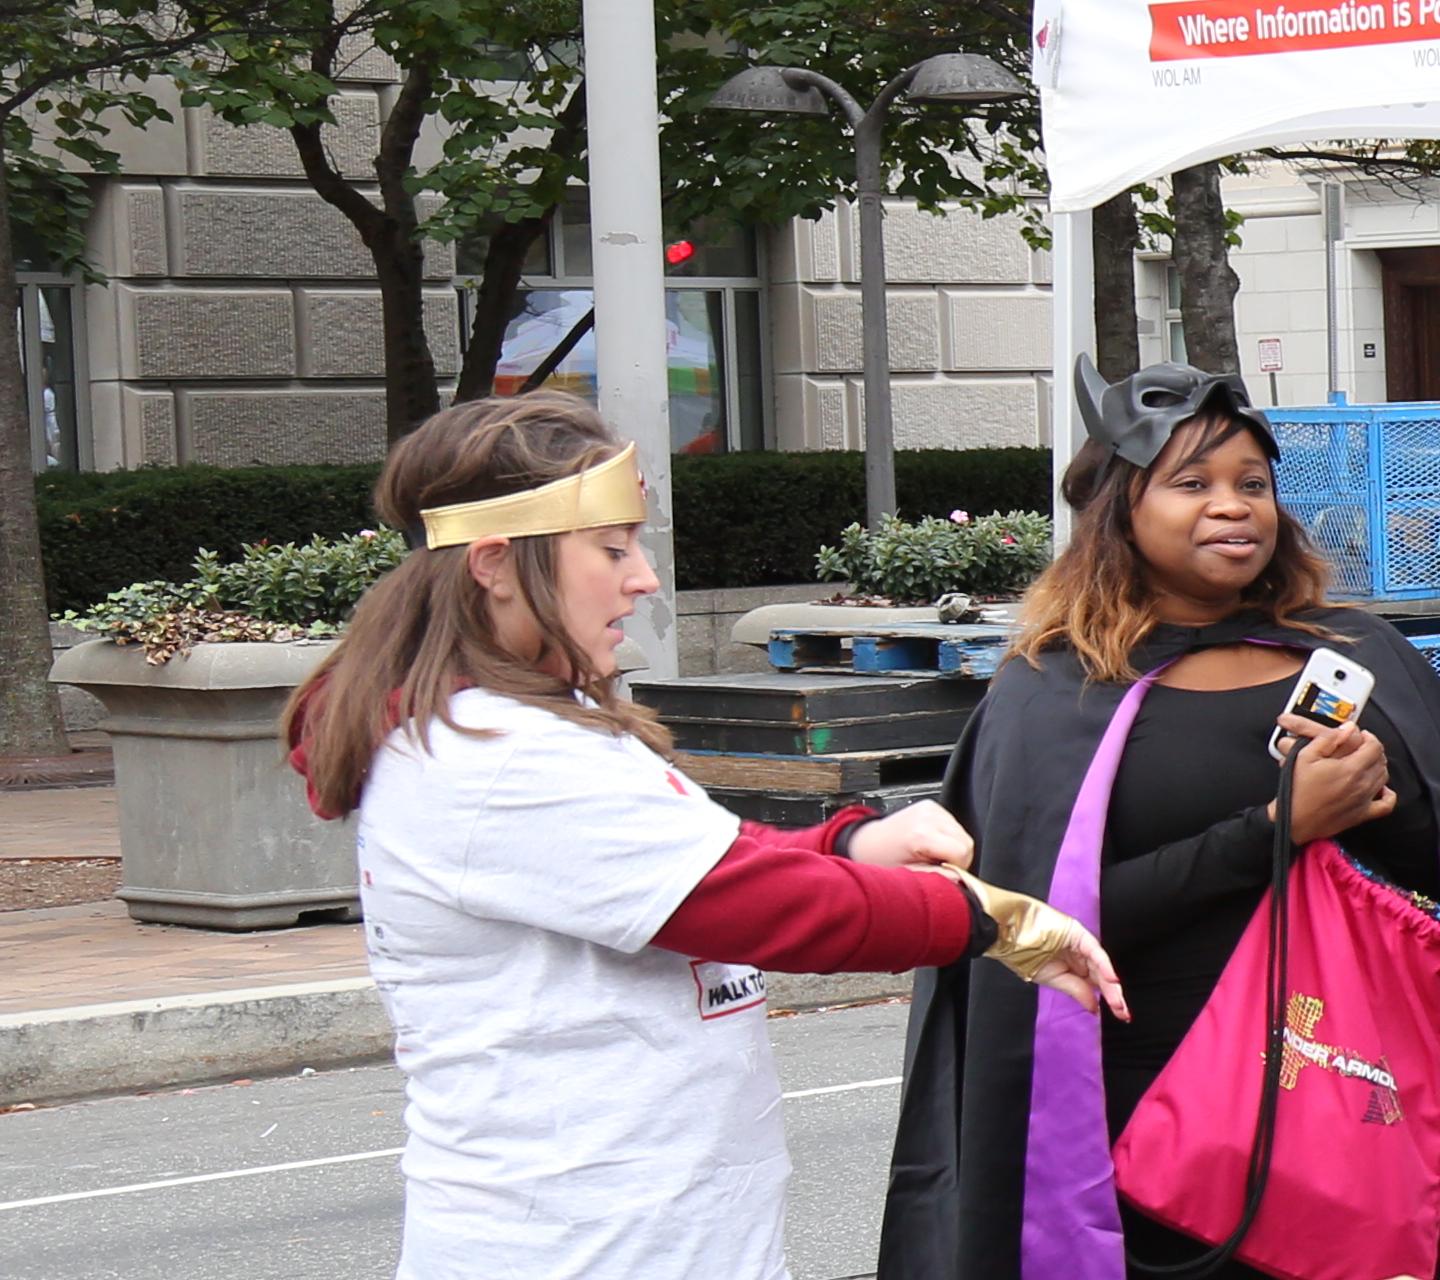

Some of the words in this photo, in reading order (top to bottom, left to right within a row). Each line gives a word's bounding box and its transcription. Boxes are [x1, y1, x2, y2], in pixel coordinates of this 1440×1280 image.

[1179, 13, 1249, 48] Where
[1256, 2, 1385, 41] Information
[1393, 0, 1412, 28] is
[708, 976, 752, 1007] WALK
[1282, 1026, 1330, 1064] NDER
